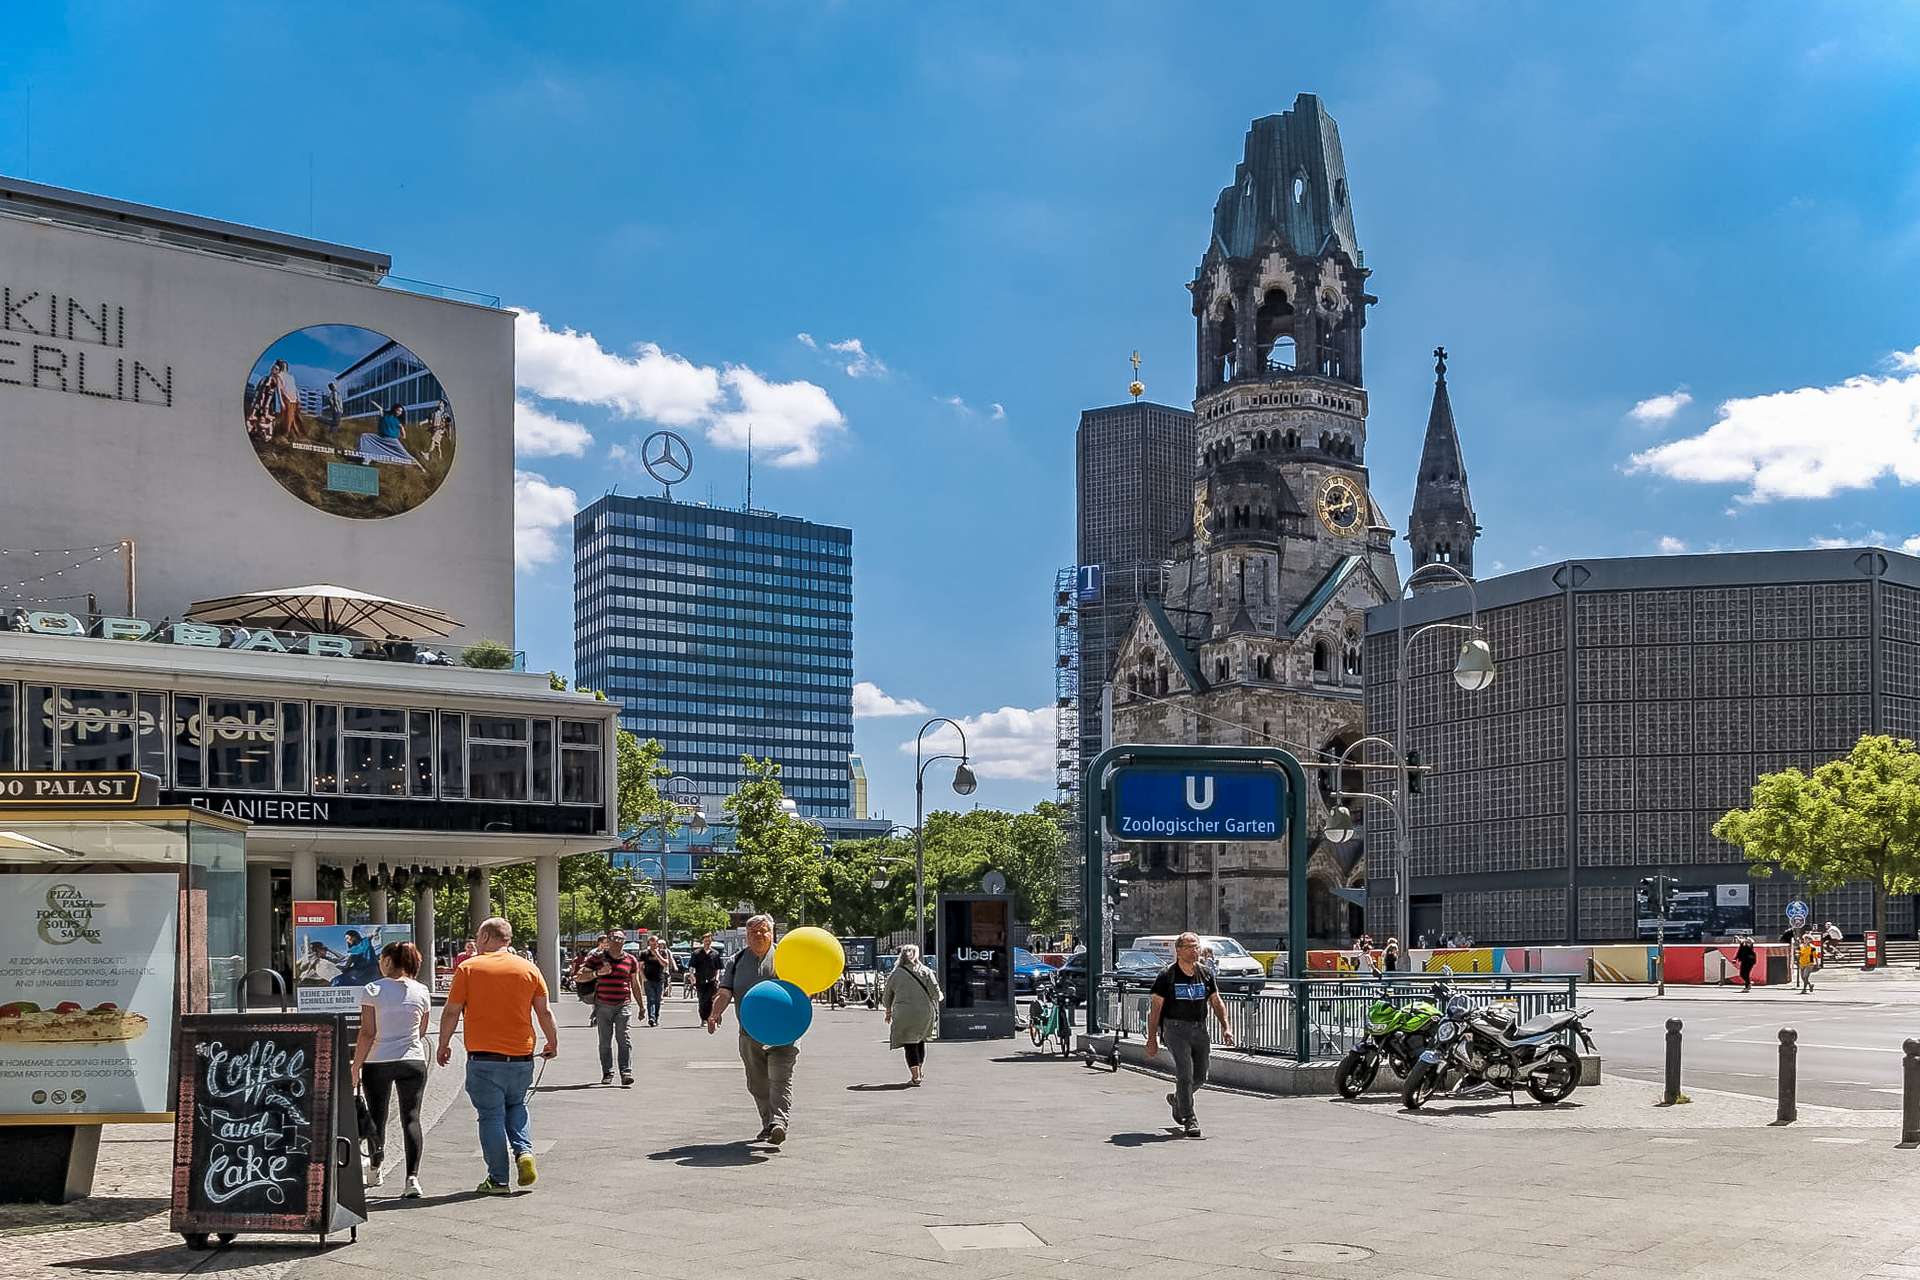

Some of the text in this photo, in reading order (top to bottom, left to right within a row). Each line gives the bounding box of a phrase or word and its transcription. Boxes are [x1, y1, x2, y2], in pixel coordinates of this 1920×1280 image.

[5, 287, 124, 348] KINI
[1080, 565, 1100, 590] T
[41, 697, 284, 746] Spreegold
[35, 780, 126, 795] PALAST
[1186, 776, 1214, 810] U
[1122, 817, 1275, 836] Zoologischer Garten
[50, 890, 83, 899] PIZZA
[62, 900, 95, 908] PASTA
[36, 910, 92, 919] FOCCACIA
[46, 920, 81, 929] SOUPS
[61, 929, 101, 938] SALADS
[957, 947, 995, 961] Uber
[83, 1069, 112, 1078] GOOD
[207, 1041, 307, 1106] Coffee
[220, 1111, 274, 1138] and
[203, 1143, 297, 1204] Cake
